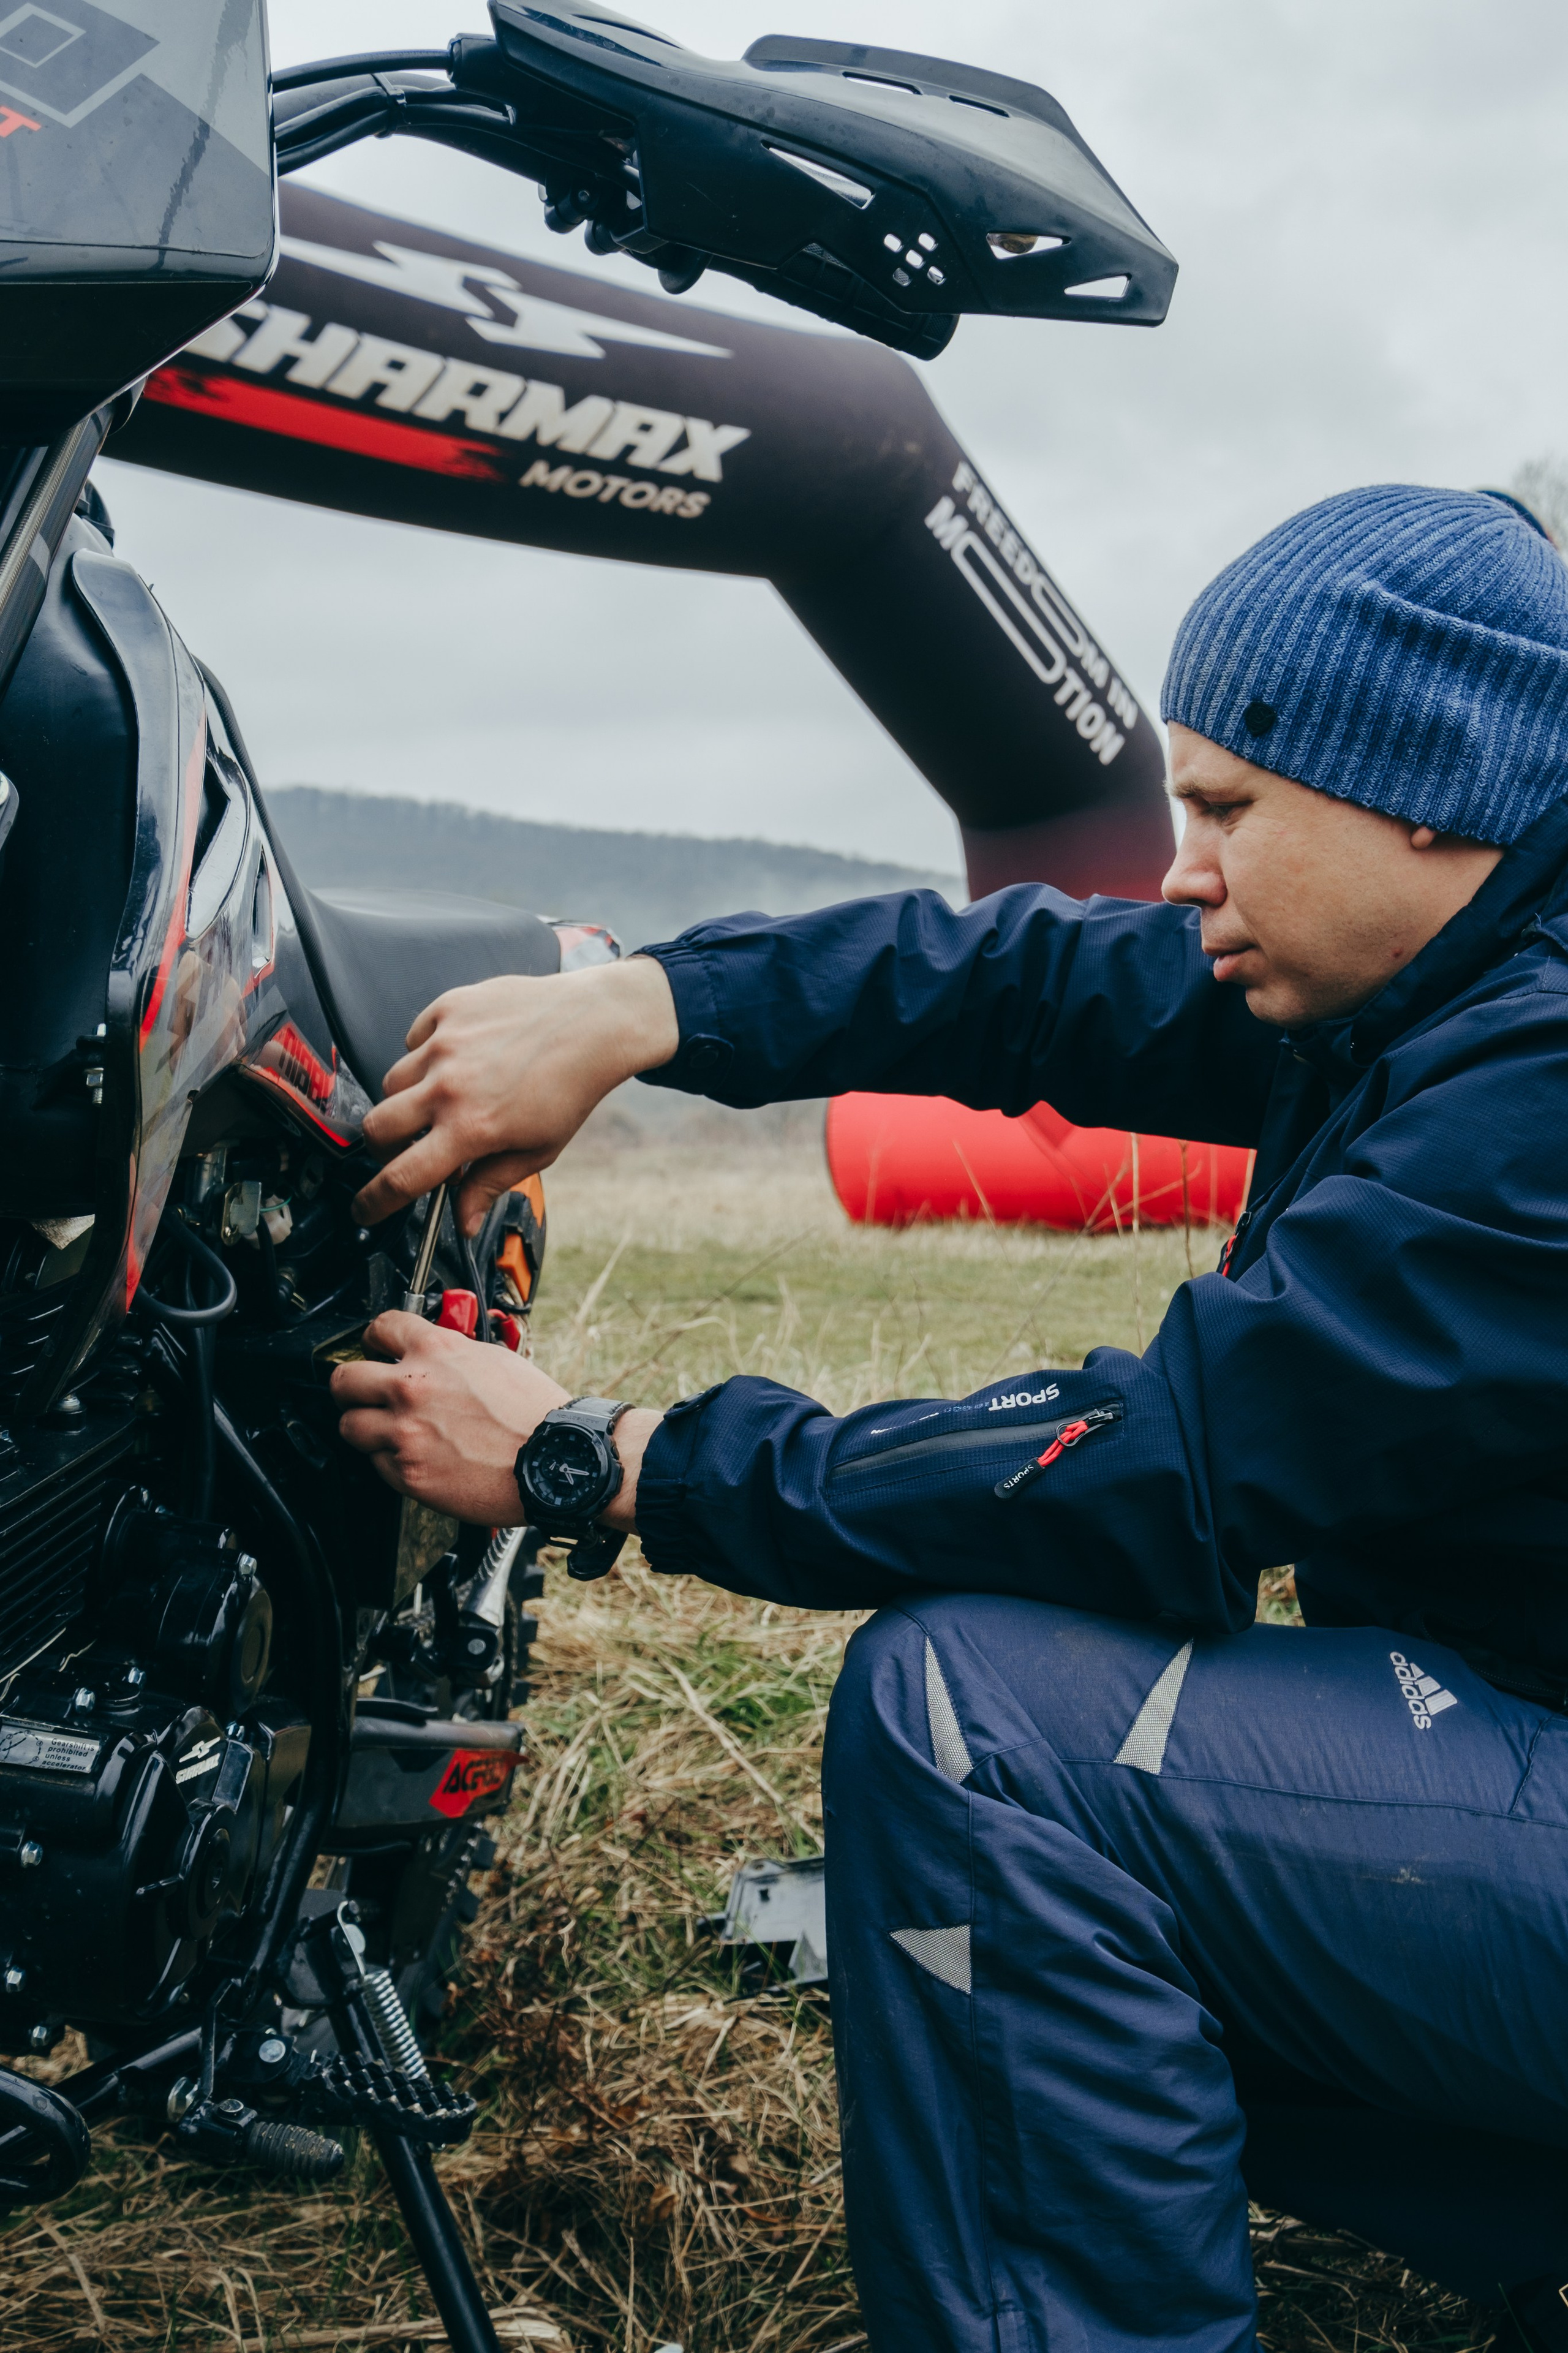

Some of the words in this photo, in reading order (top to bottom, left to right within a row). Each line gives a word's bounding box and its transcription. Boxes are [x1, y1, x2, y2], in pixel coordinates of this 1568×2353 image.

[518, 459, 711, 519] MOTORS
[951, 460, 1110, 689] FREEDOM
[1106, 676, 1139, 730] IN
[924, 495, 1126, 766] MOTION
[988, 1383, 1060, 1411] SPORT
[1003, 1464, 1035, 1490] SPORTS
[1390, 1652, 1431, 1729] adidas
[47, 1746, 88, 1758] prohibited
[51, 1737, 87, 1750] Gearshift
[42, 1760, 86, 1771] accelerator
[45, 1753, 70, 1762] unless
